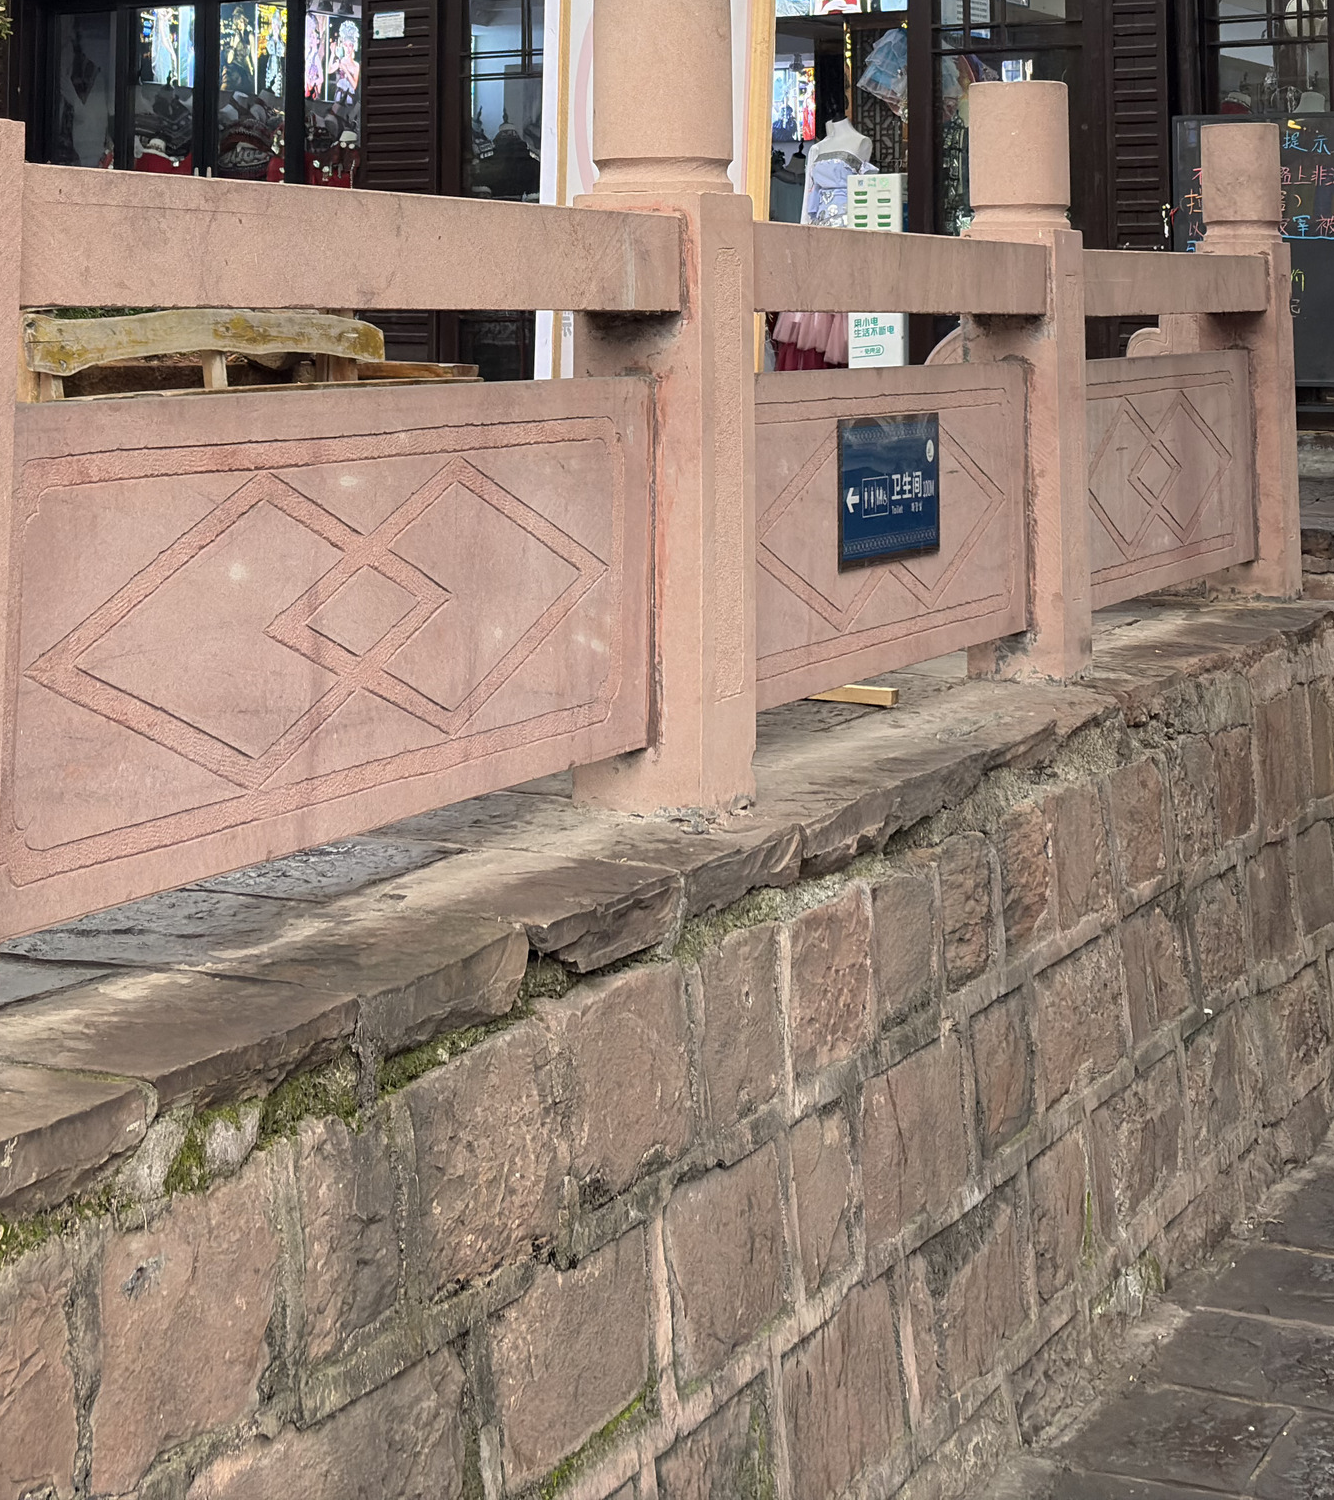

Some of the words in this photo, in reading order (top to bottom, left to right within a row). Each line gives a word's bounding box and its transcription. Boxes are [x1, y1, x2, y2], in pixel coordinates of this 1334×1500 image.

[1282, 131, 1331, 155] 提示
[891, 471, 923, 500] 卫生间
